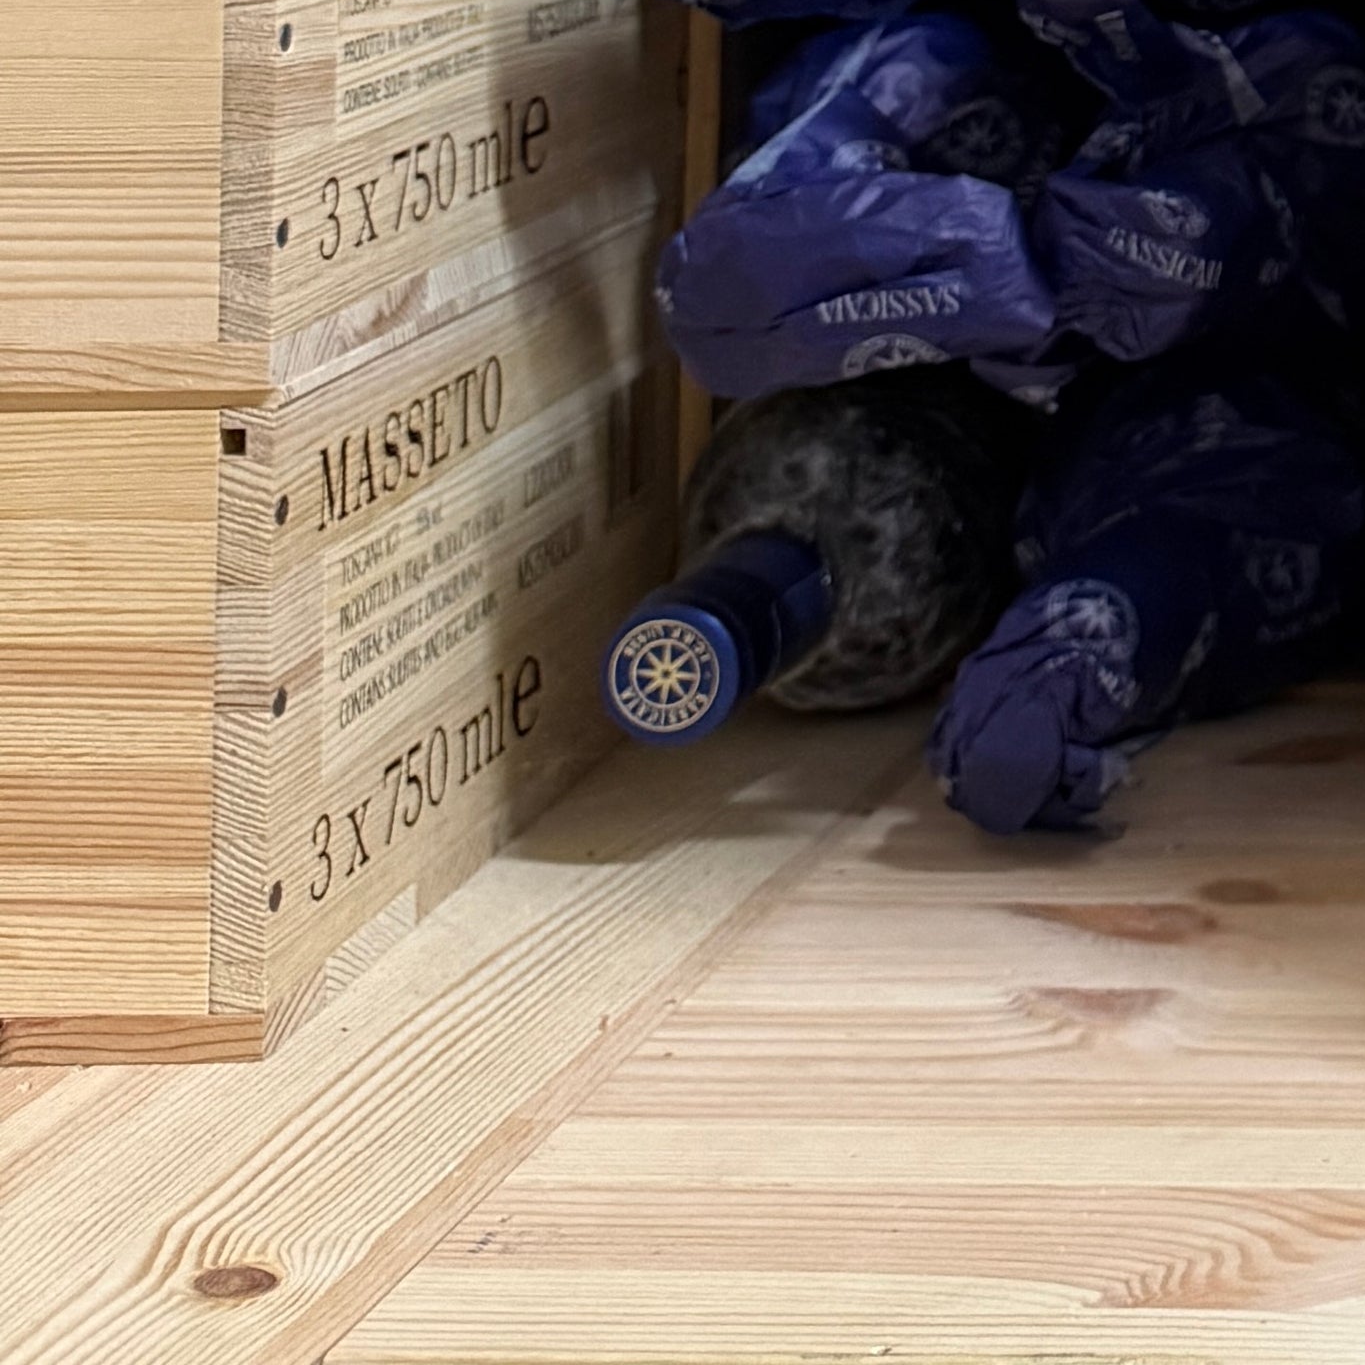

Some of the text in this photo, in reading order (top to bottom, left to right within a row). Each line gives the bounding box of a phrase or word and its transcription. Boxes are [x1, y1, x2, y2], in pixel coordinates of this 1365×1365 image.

[319, 176, 342, 262] 3
[354, 179, 381, 248] x
[317, 354, 503, 532] MASSETO
[309, 814, 333, 903] 3
[345, 792, 371, 876] x
